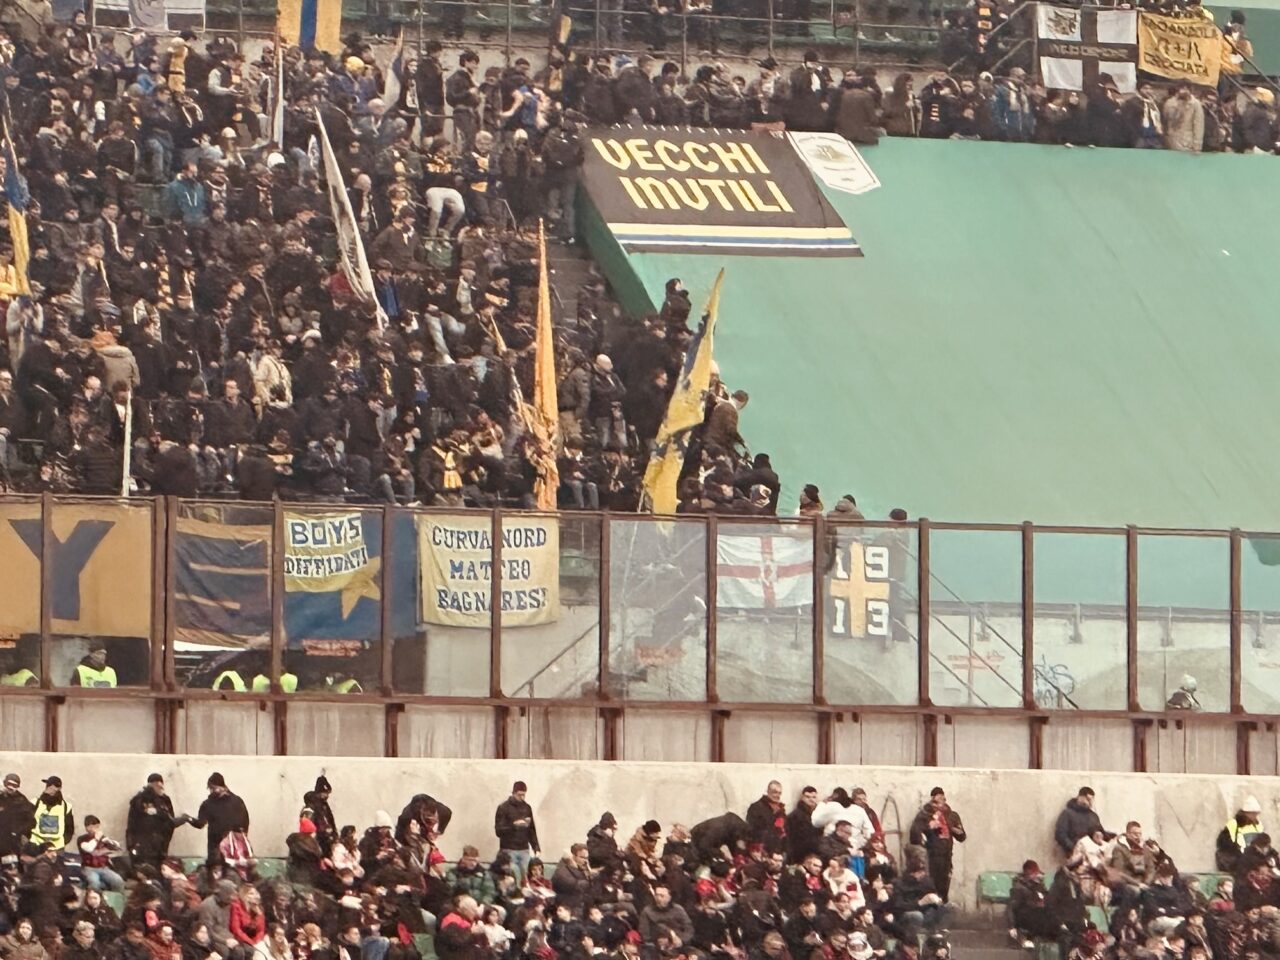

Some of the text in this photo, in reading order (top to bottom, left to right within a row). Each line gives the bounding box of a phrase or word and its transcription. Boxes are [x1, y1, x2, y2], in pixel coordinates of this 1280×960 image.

[592, 137, 771, 174] VECCHI
[620, 176, 794, 213] INUTILI
[289, 515, 363, 547] BOYS
[432, 525, 548, 550] CURVA NORD
[283, 546, 369, 575] DIFFIDATI
[437, 586, 549, 614] BAGNRESI
